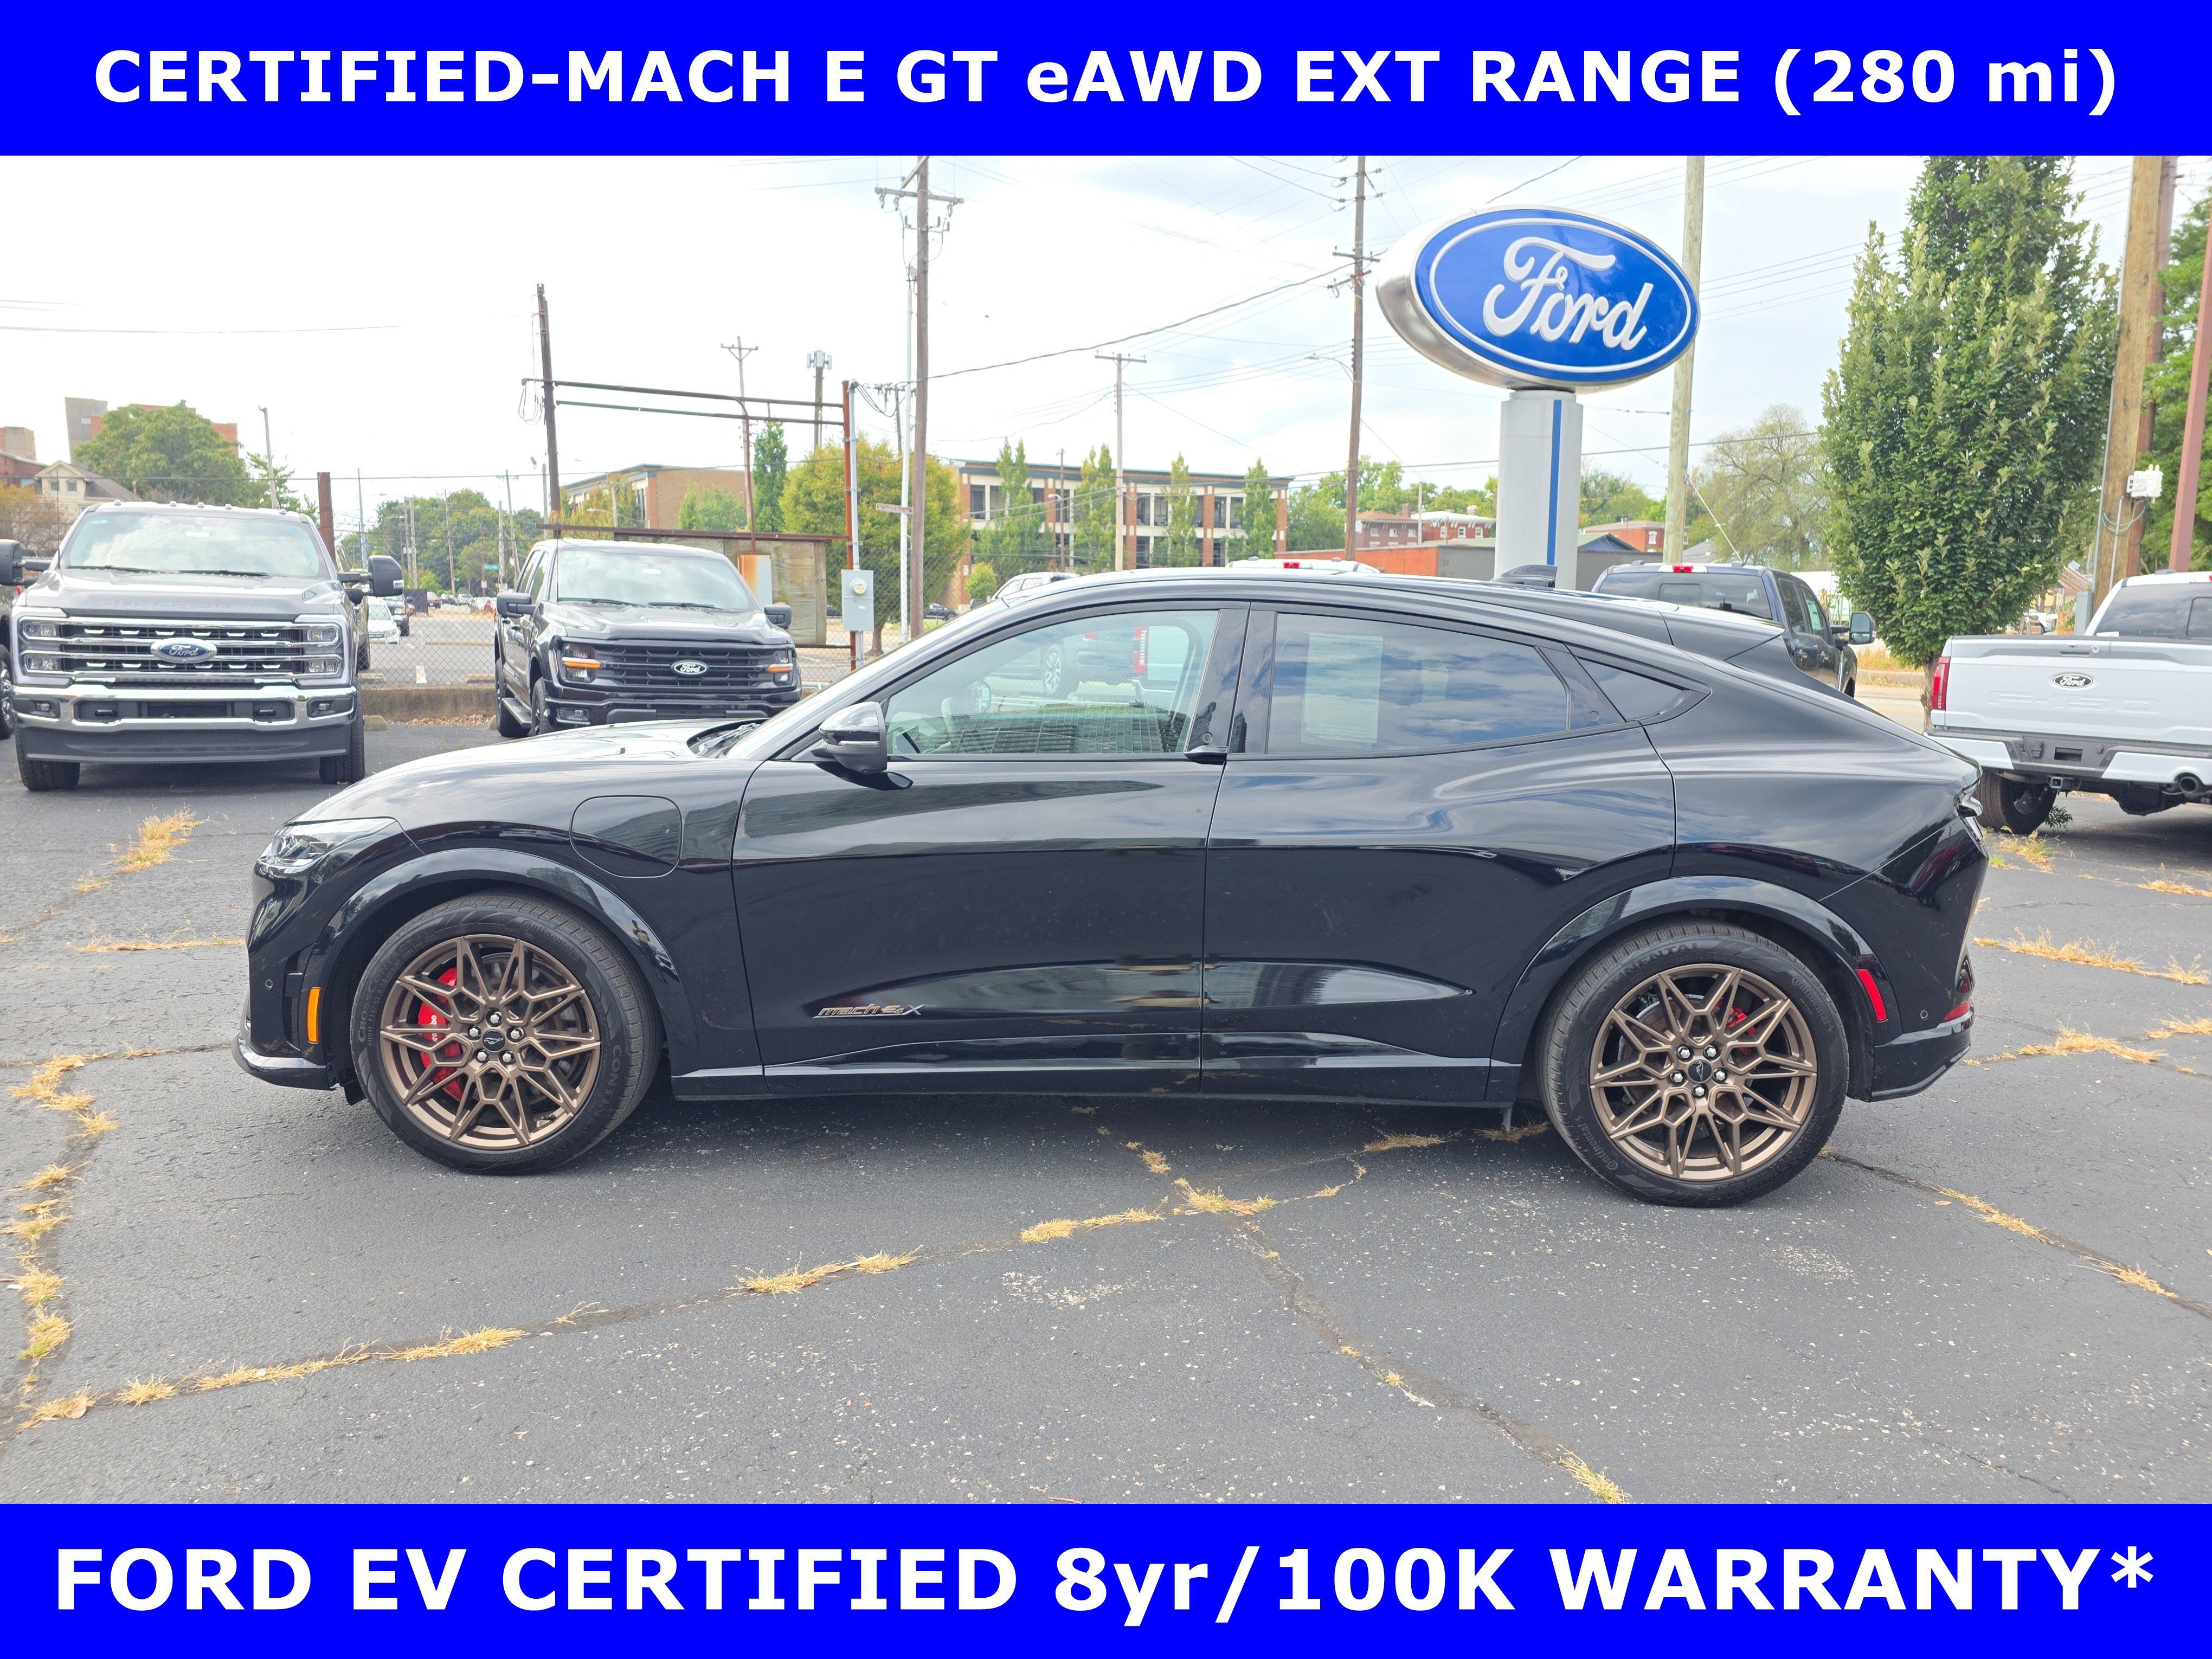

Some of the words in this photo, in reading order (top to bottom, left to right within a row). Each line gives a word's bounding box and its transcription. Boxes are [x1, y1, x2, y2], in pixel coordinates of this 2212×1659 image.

[1483, 236, 1654, 350] Ford
[169, 645, 198, 656] Ford
[680, 663, 700, 672] Ford
[2059, 674, 2085, 686] Ford
[1988, 691, 2160, 715] F-150
[1580, 942, 1704, 1025] CONTINENTAL
[1578, 1122, 1619, 1171] Continental
